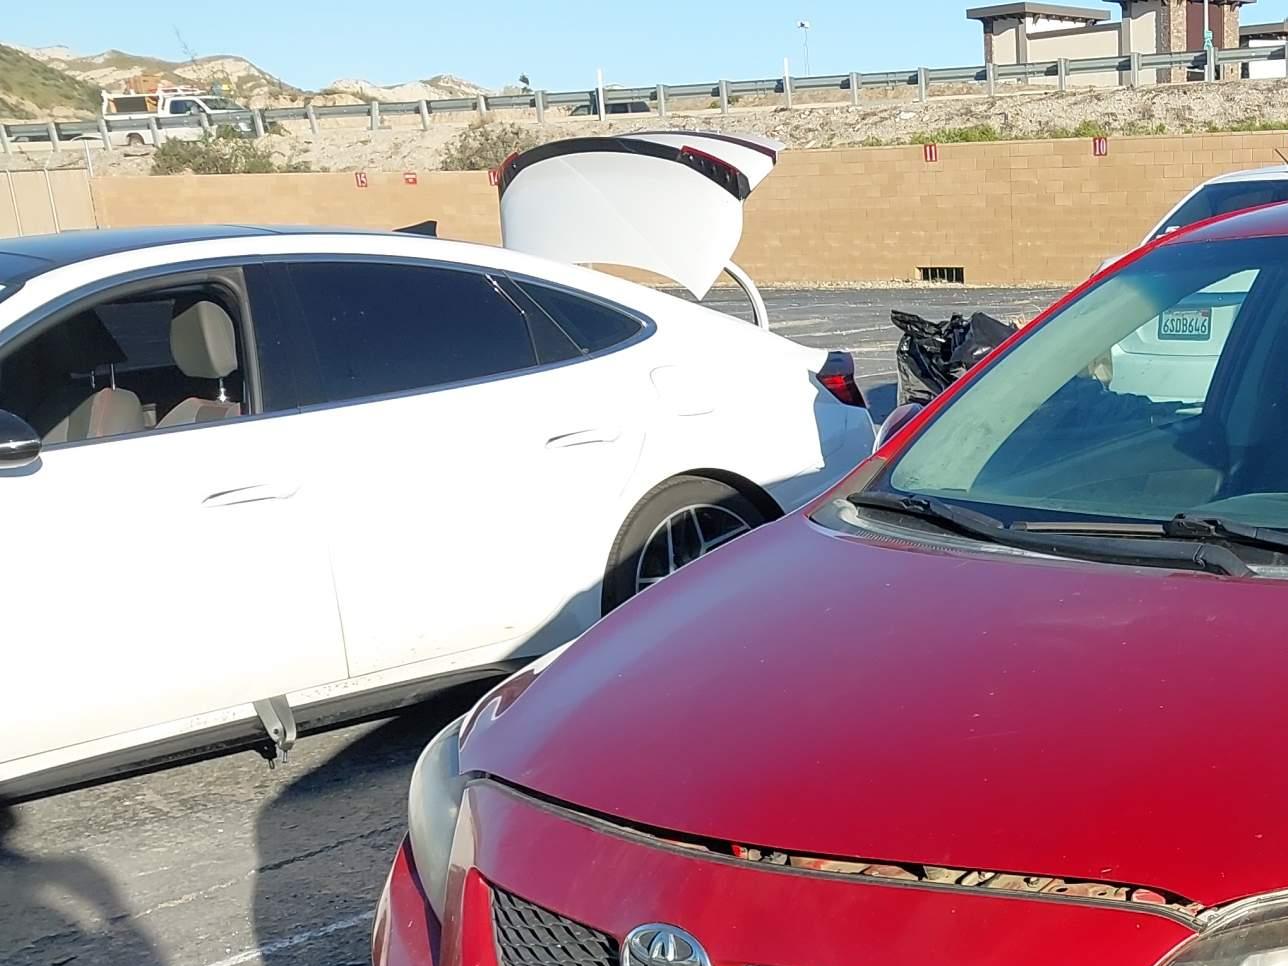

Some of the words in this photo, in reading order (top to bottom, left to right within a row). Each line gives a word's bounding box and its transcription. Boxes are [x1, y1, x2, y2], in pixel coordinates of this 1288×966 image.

[926, 145, 936, 161] 11
[1095, 138, 1106, 155] 10
[356, 173, 367, 186] 15
[1163, 318, 1208, 333] 6SDB646
